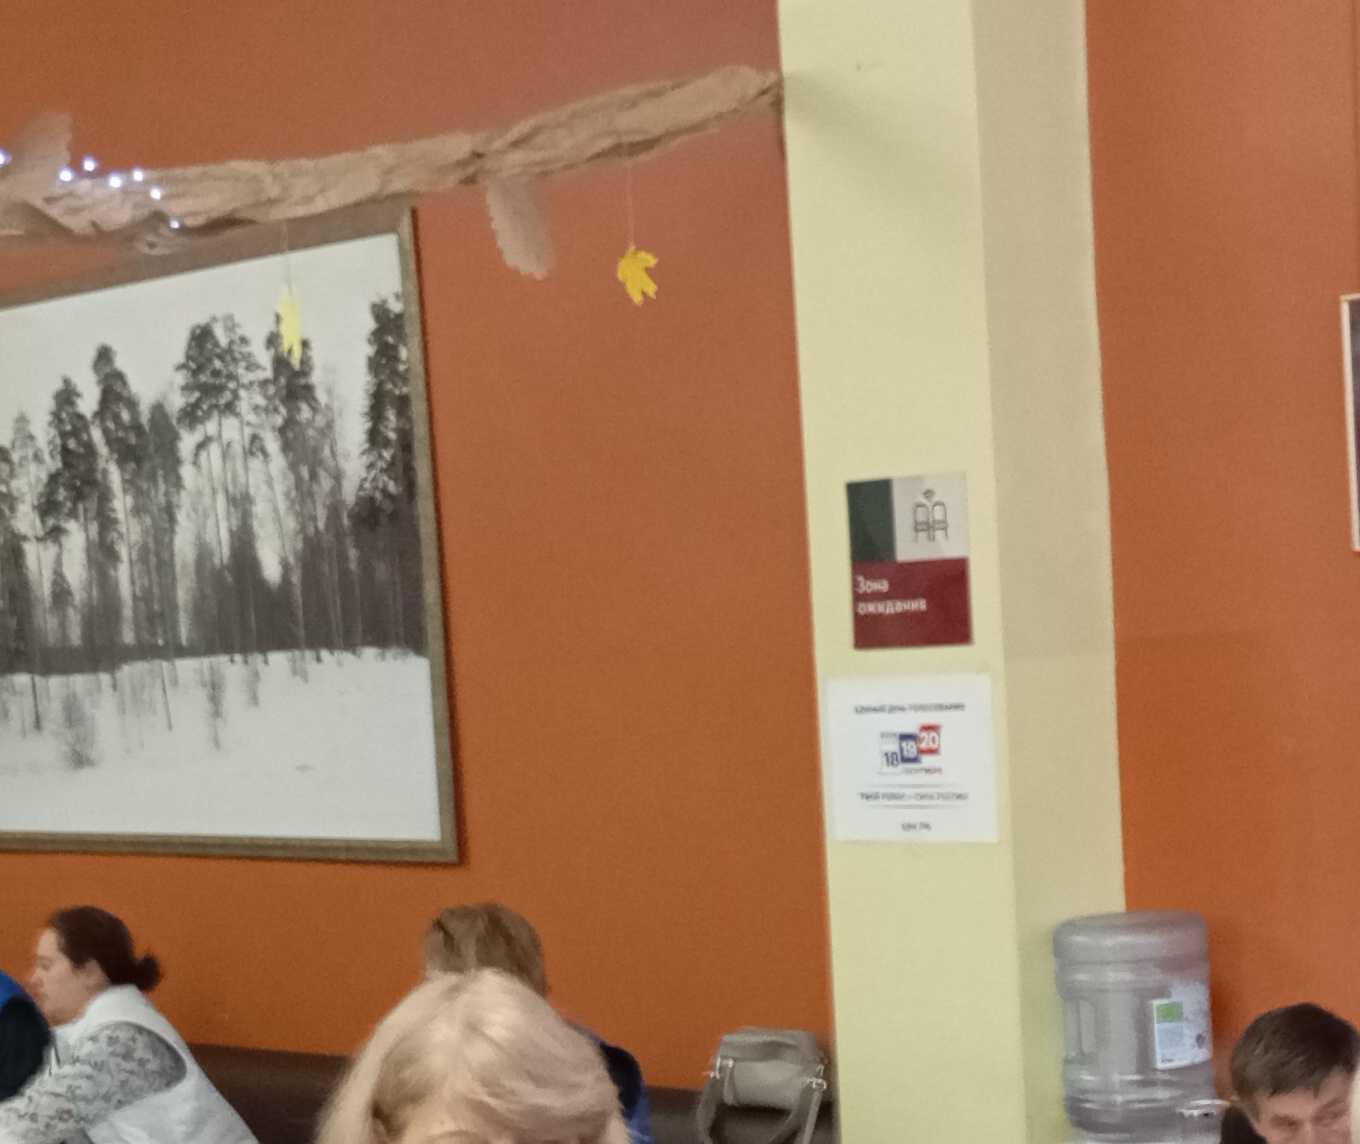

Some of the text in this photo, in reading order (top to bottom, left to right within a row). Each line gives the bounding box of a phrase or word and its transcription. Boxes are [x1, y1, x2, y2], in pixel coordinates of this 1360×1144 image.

[855, 575, 889, 594] Зона
[857, 598, 927, 615] ожидания
[919, 730, 940, 749] 20
